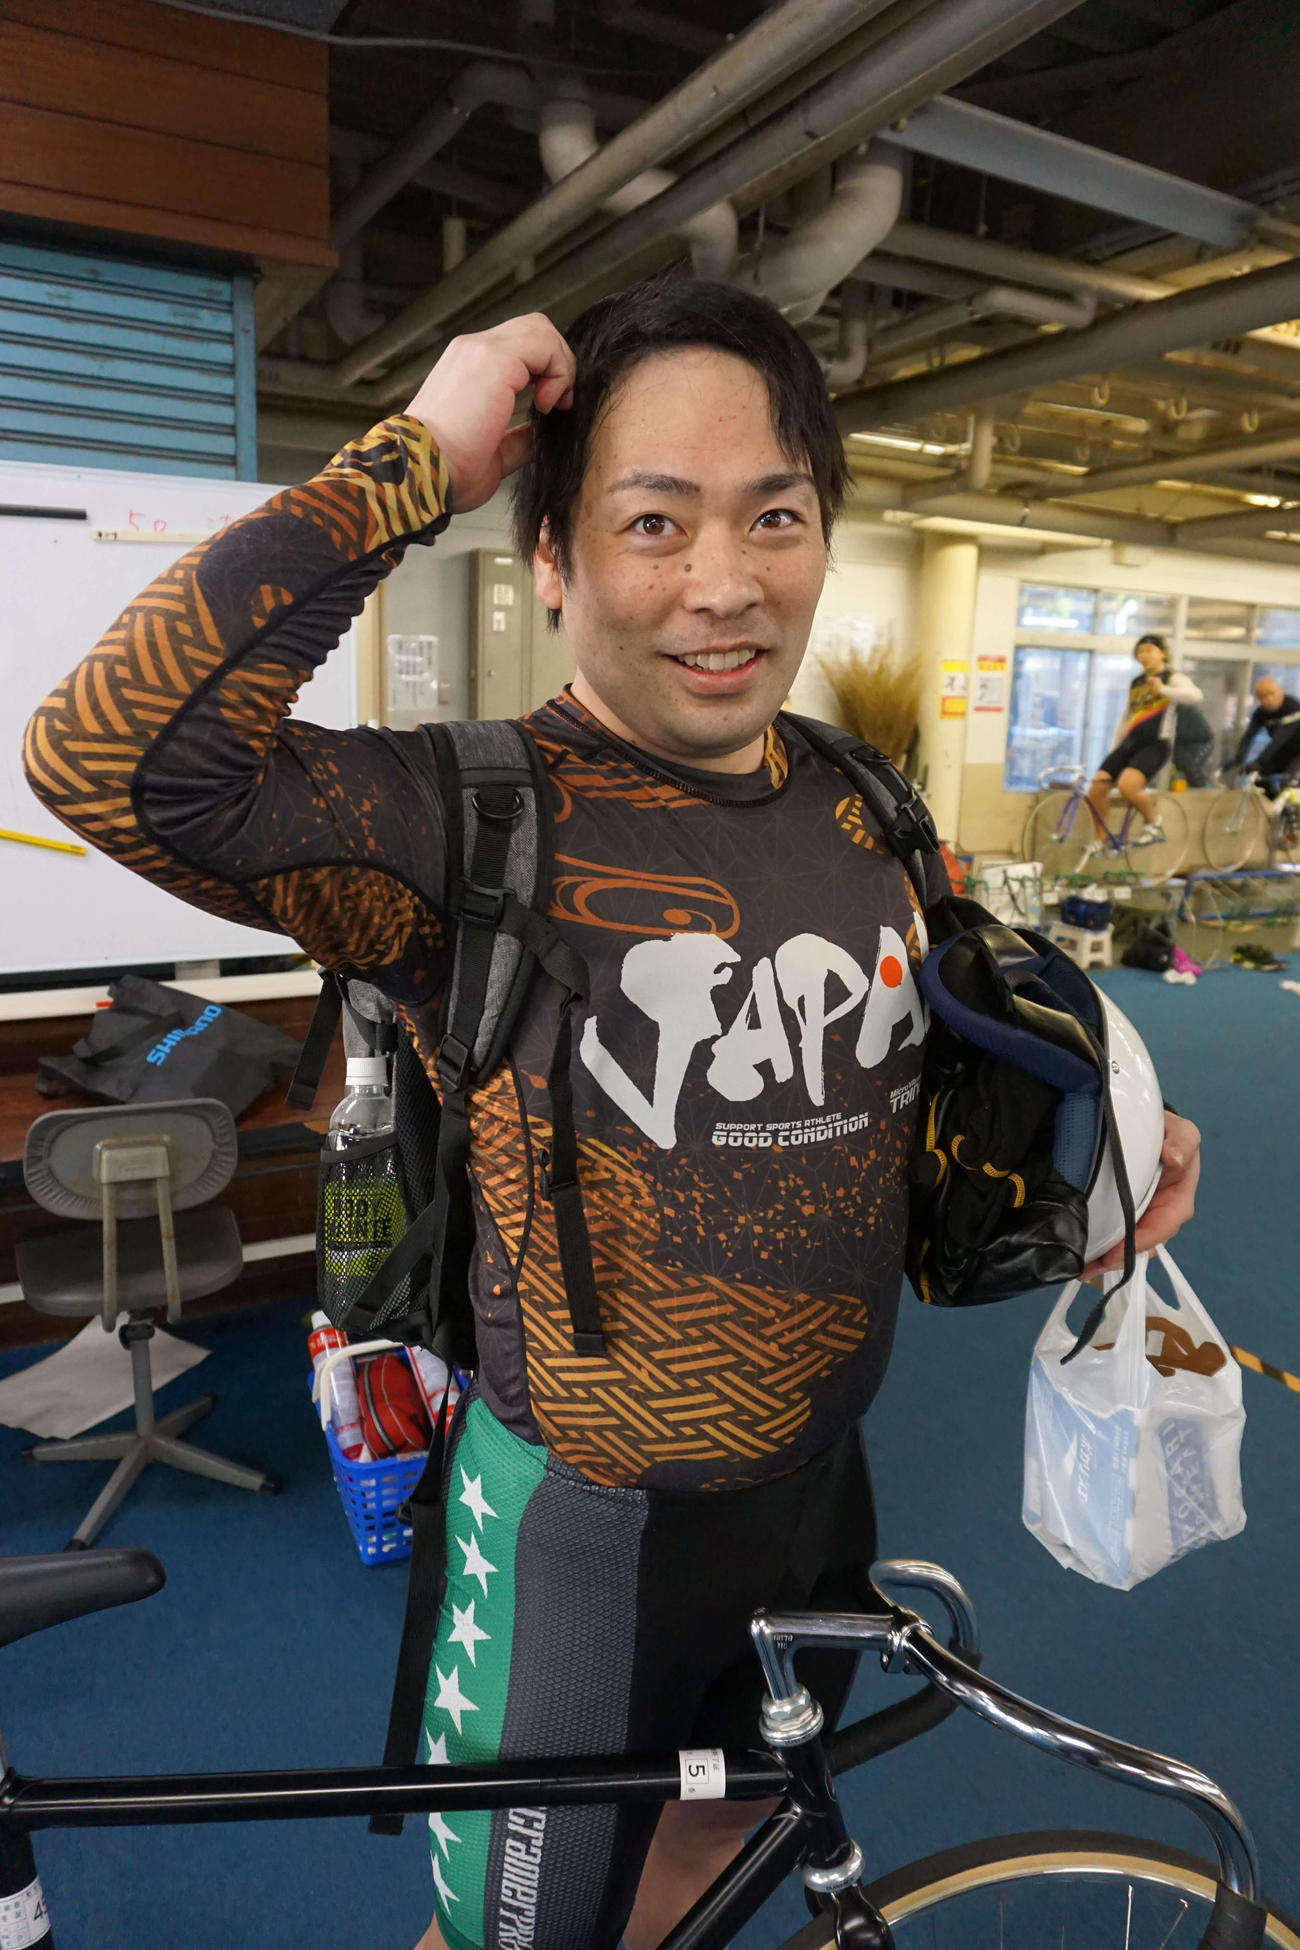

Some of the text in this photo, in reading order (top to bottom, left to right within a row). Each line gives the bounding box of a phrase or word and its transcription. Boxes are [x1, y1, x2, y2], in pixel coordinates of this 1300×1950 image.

[711, 1112, 869, 1147] GOOD CONDITION
[715, 1112, 842, 1131] SUPPORT SPORTS ATHLETE
[688, 1764, 706, 1778] 5
